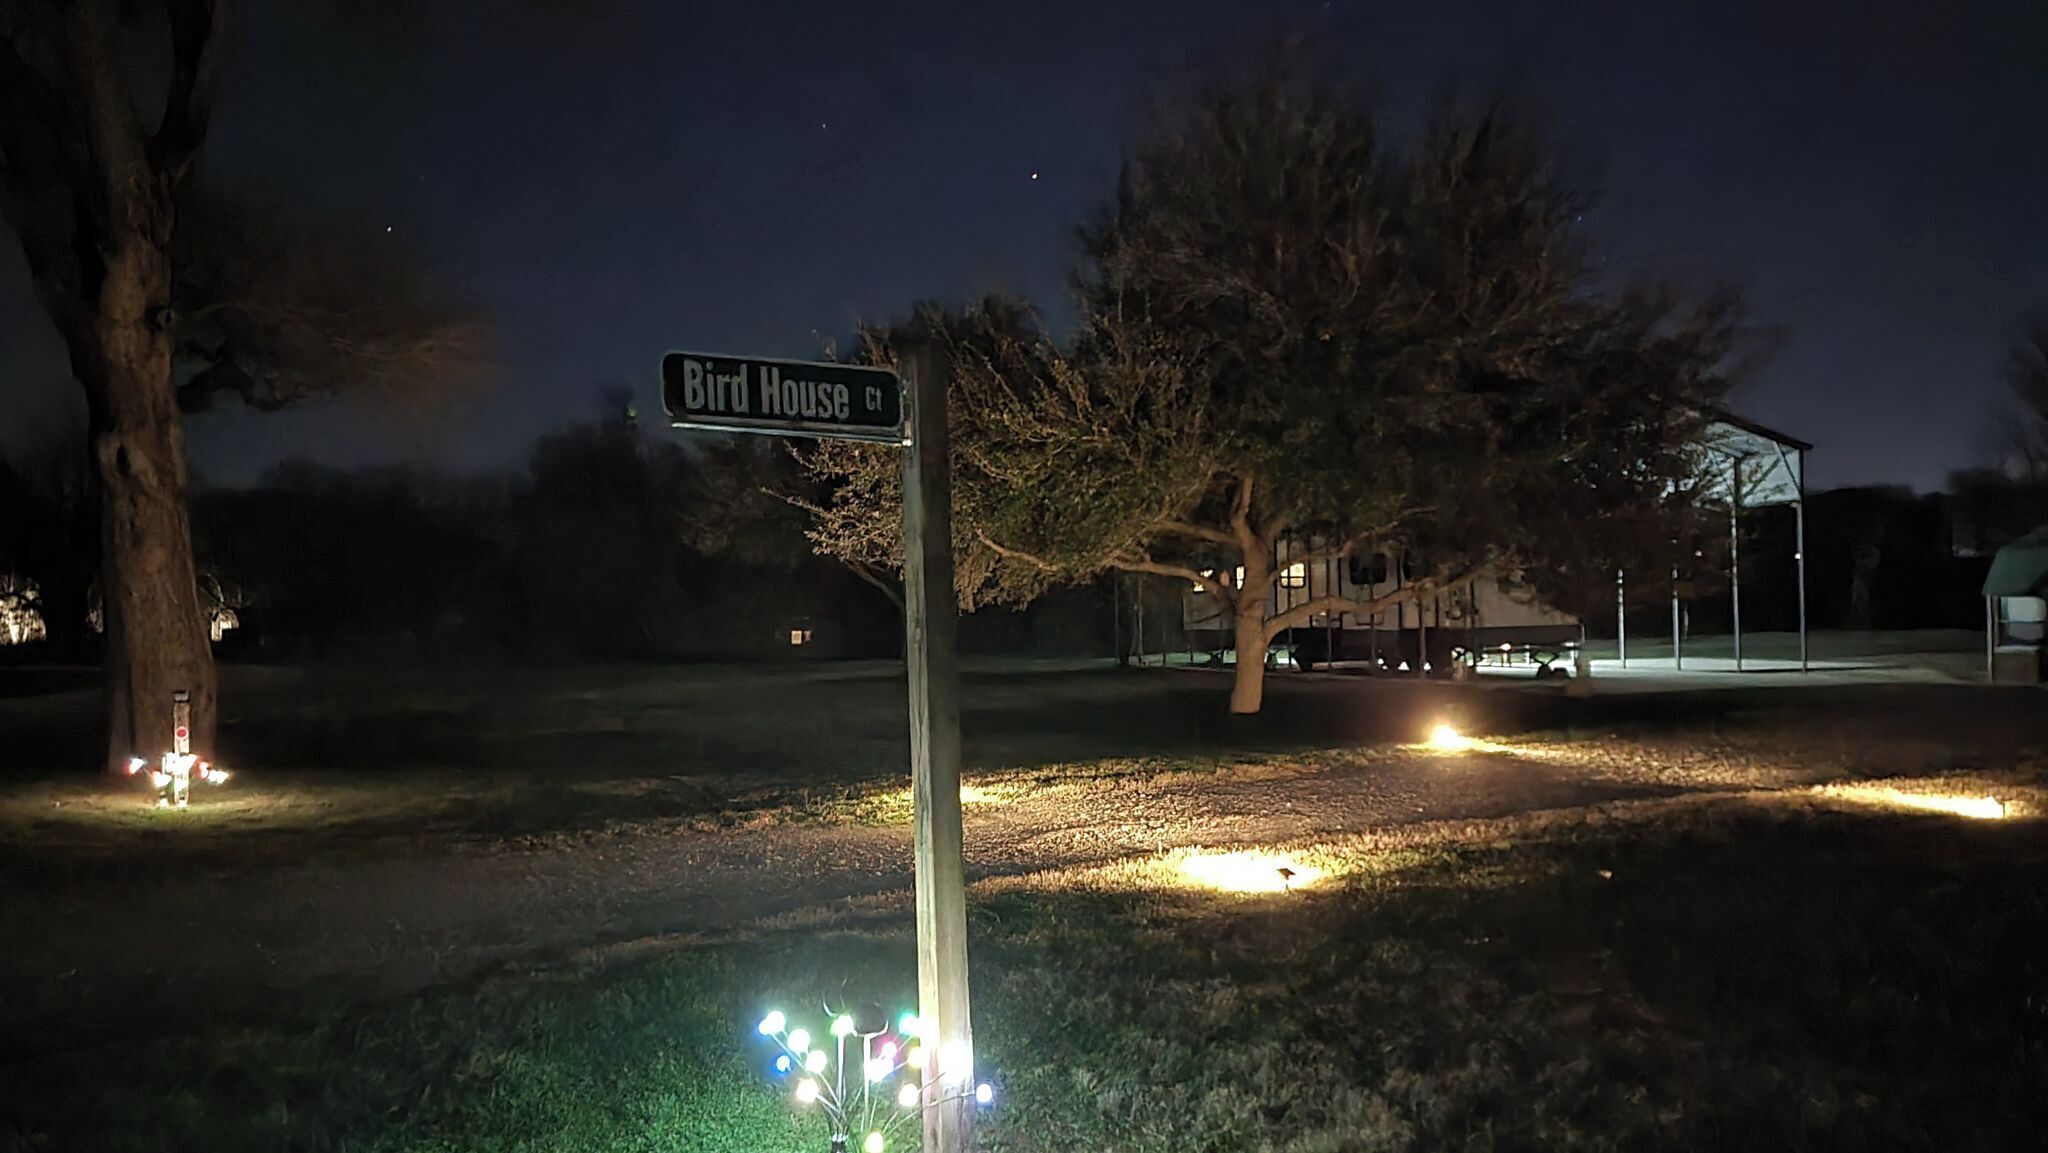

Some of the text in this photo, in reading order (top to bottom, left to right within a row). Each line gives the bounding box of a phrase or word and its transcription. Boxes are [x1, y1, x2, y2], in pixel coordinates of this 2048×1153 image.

[683, 359, 882, 419] Bird House Ct
